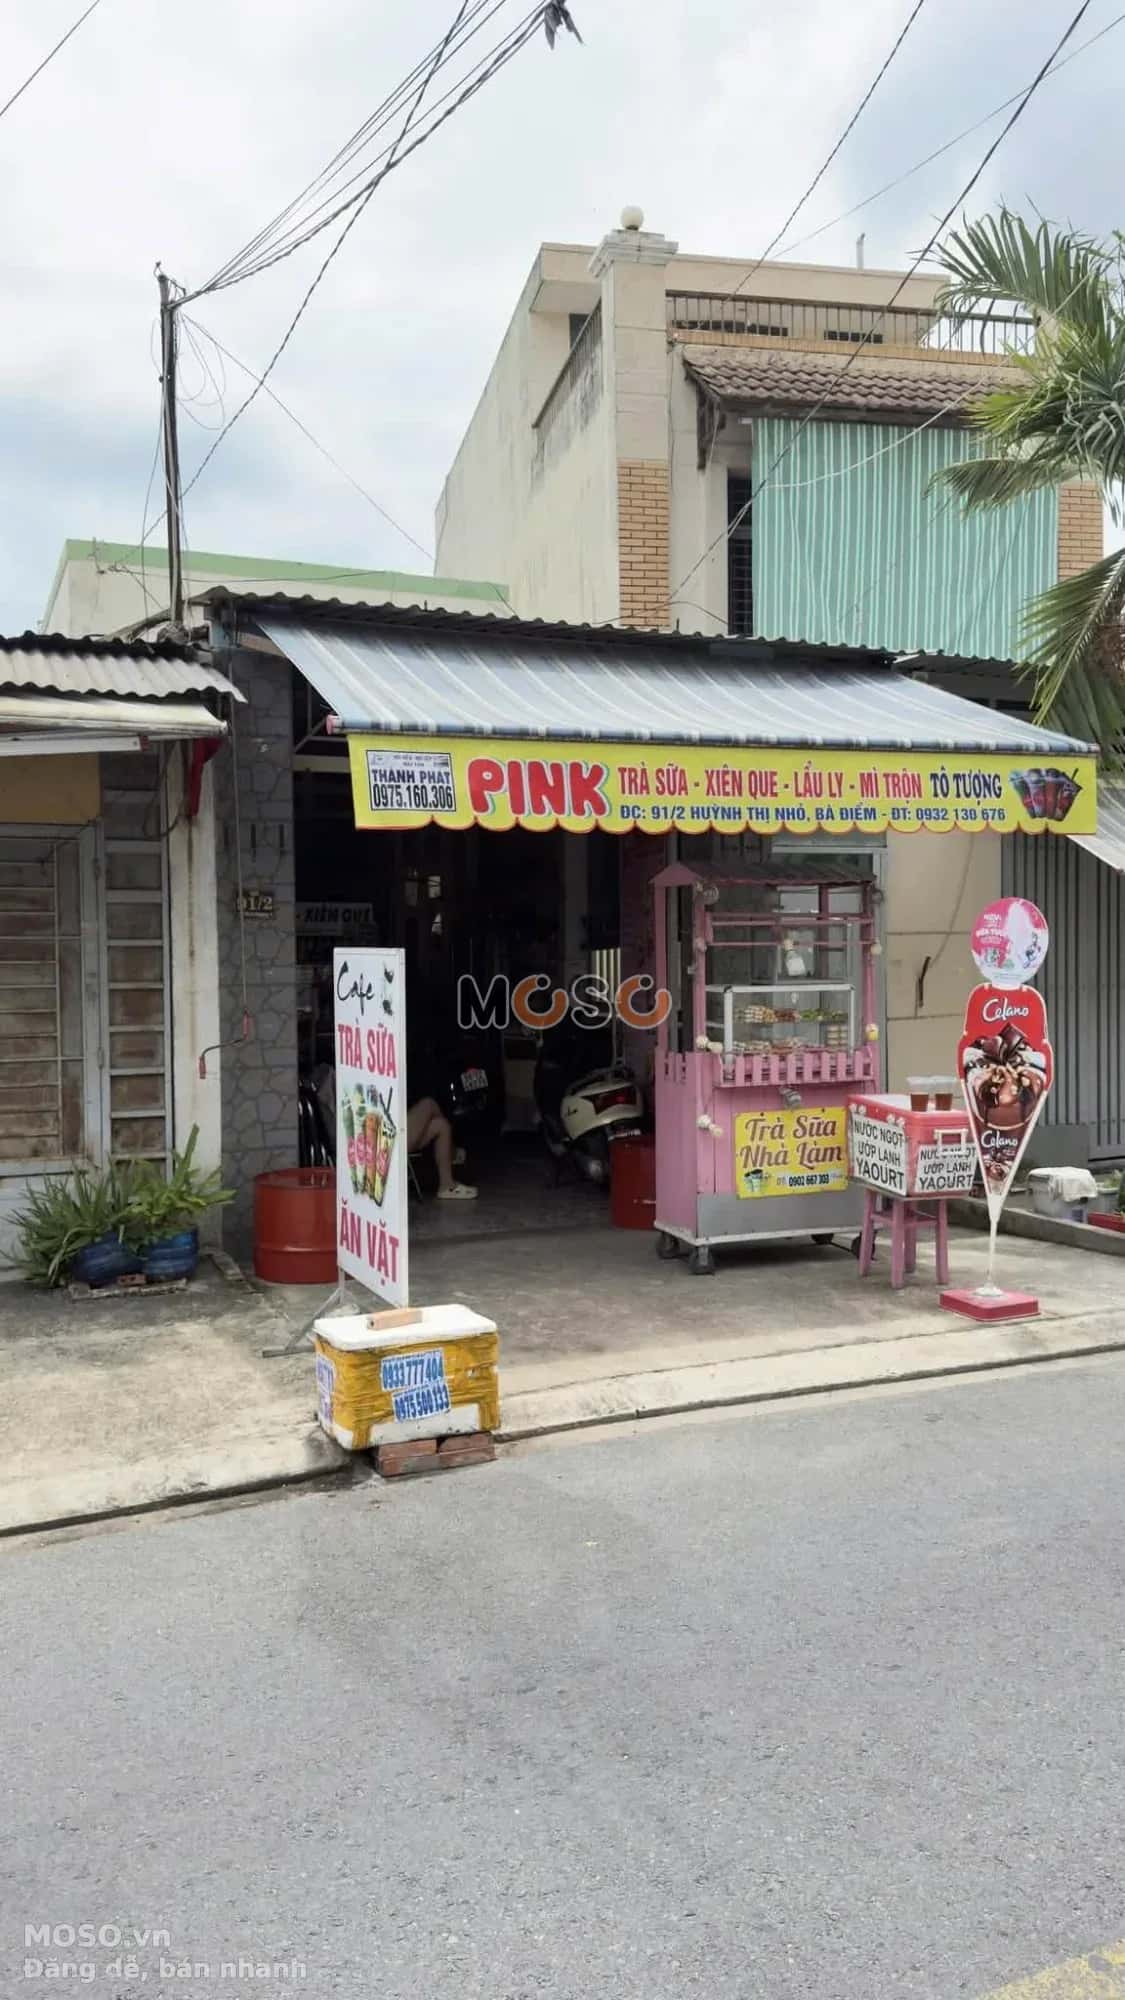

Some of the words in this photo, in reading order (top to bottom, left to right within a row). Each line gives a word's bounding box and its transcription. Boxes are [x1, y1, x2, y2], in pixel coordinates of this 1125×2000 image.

[373, 784, 453, 808] 0975.160.306
[467, 756, 611, 817] PINK
[618, 762, 650, 795] TRÀ
[656, 763, 688, 796] SỮA
[705, 764, 742, 797] XIÊN
[749, 770, 778, 799] QUE
[828, 771, 843, 798] LY
[859, 767, 879, 798] MÌ
[930, 765, 949, 798] TÔ
[953, 769, 1002, 806] TƯỢNG
[620, 805, 646, 820] ĐC:
[651, 805, 685, 820] 91/2
[691, 804, 741, 820] HUỲNH
[749, 807, 769, 824] THỊ
[815, 803, 835, 821] BÀ
[840, 801, 876, 820] ĐIỂM
[891, 807, 911, 820] ĐT:
[916, 807, 949, 821] 0932
[337, 960, 374, 1016] Cafe
[982, 998, 1030, 1022] Celano
[338, 1018, 362, 1069] TRÀ
[367, 1022, 397, 1079] SỮA
[745, 1116, 785, 1141] Trà
[793, 1115, 837, 1139] Sữa
[854, 1120, 878, 1139] NƯỚC
[880, 1128, 903, 1149] NGỌT
[981, 1130, 1018, 1151] Celano
[740, 1143, 789, 1168] Nhà
[797, 1141, 842, 1170] Làm
[858, 1140, 877, 1157] ƯỚP
[856, 1159, 904, 1190] YAOURT
[920, 1175, 973, 1190] YAOURT
[340, 1197, 361, 1259] ĂN
[367, 1219, 399, 1286] VẶT
